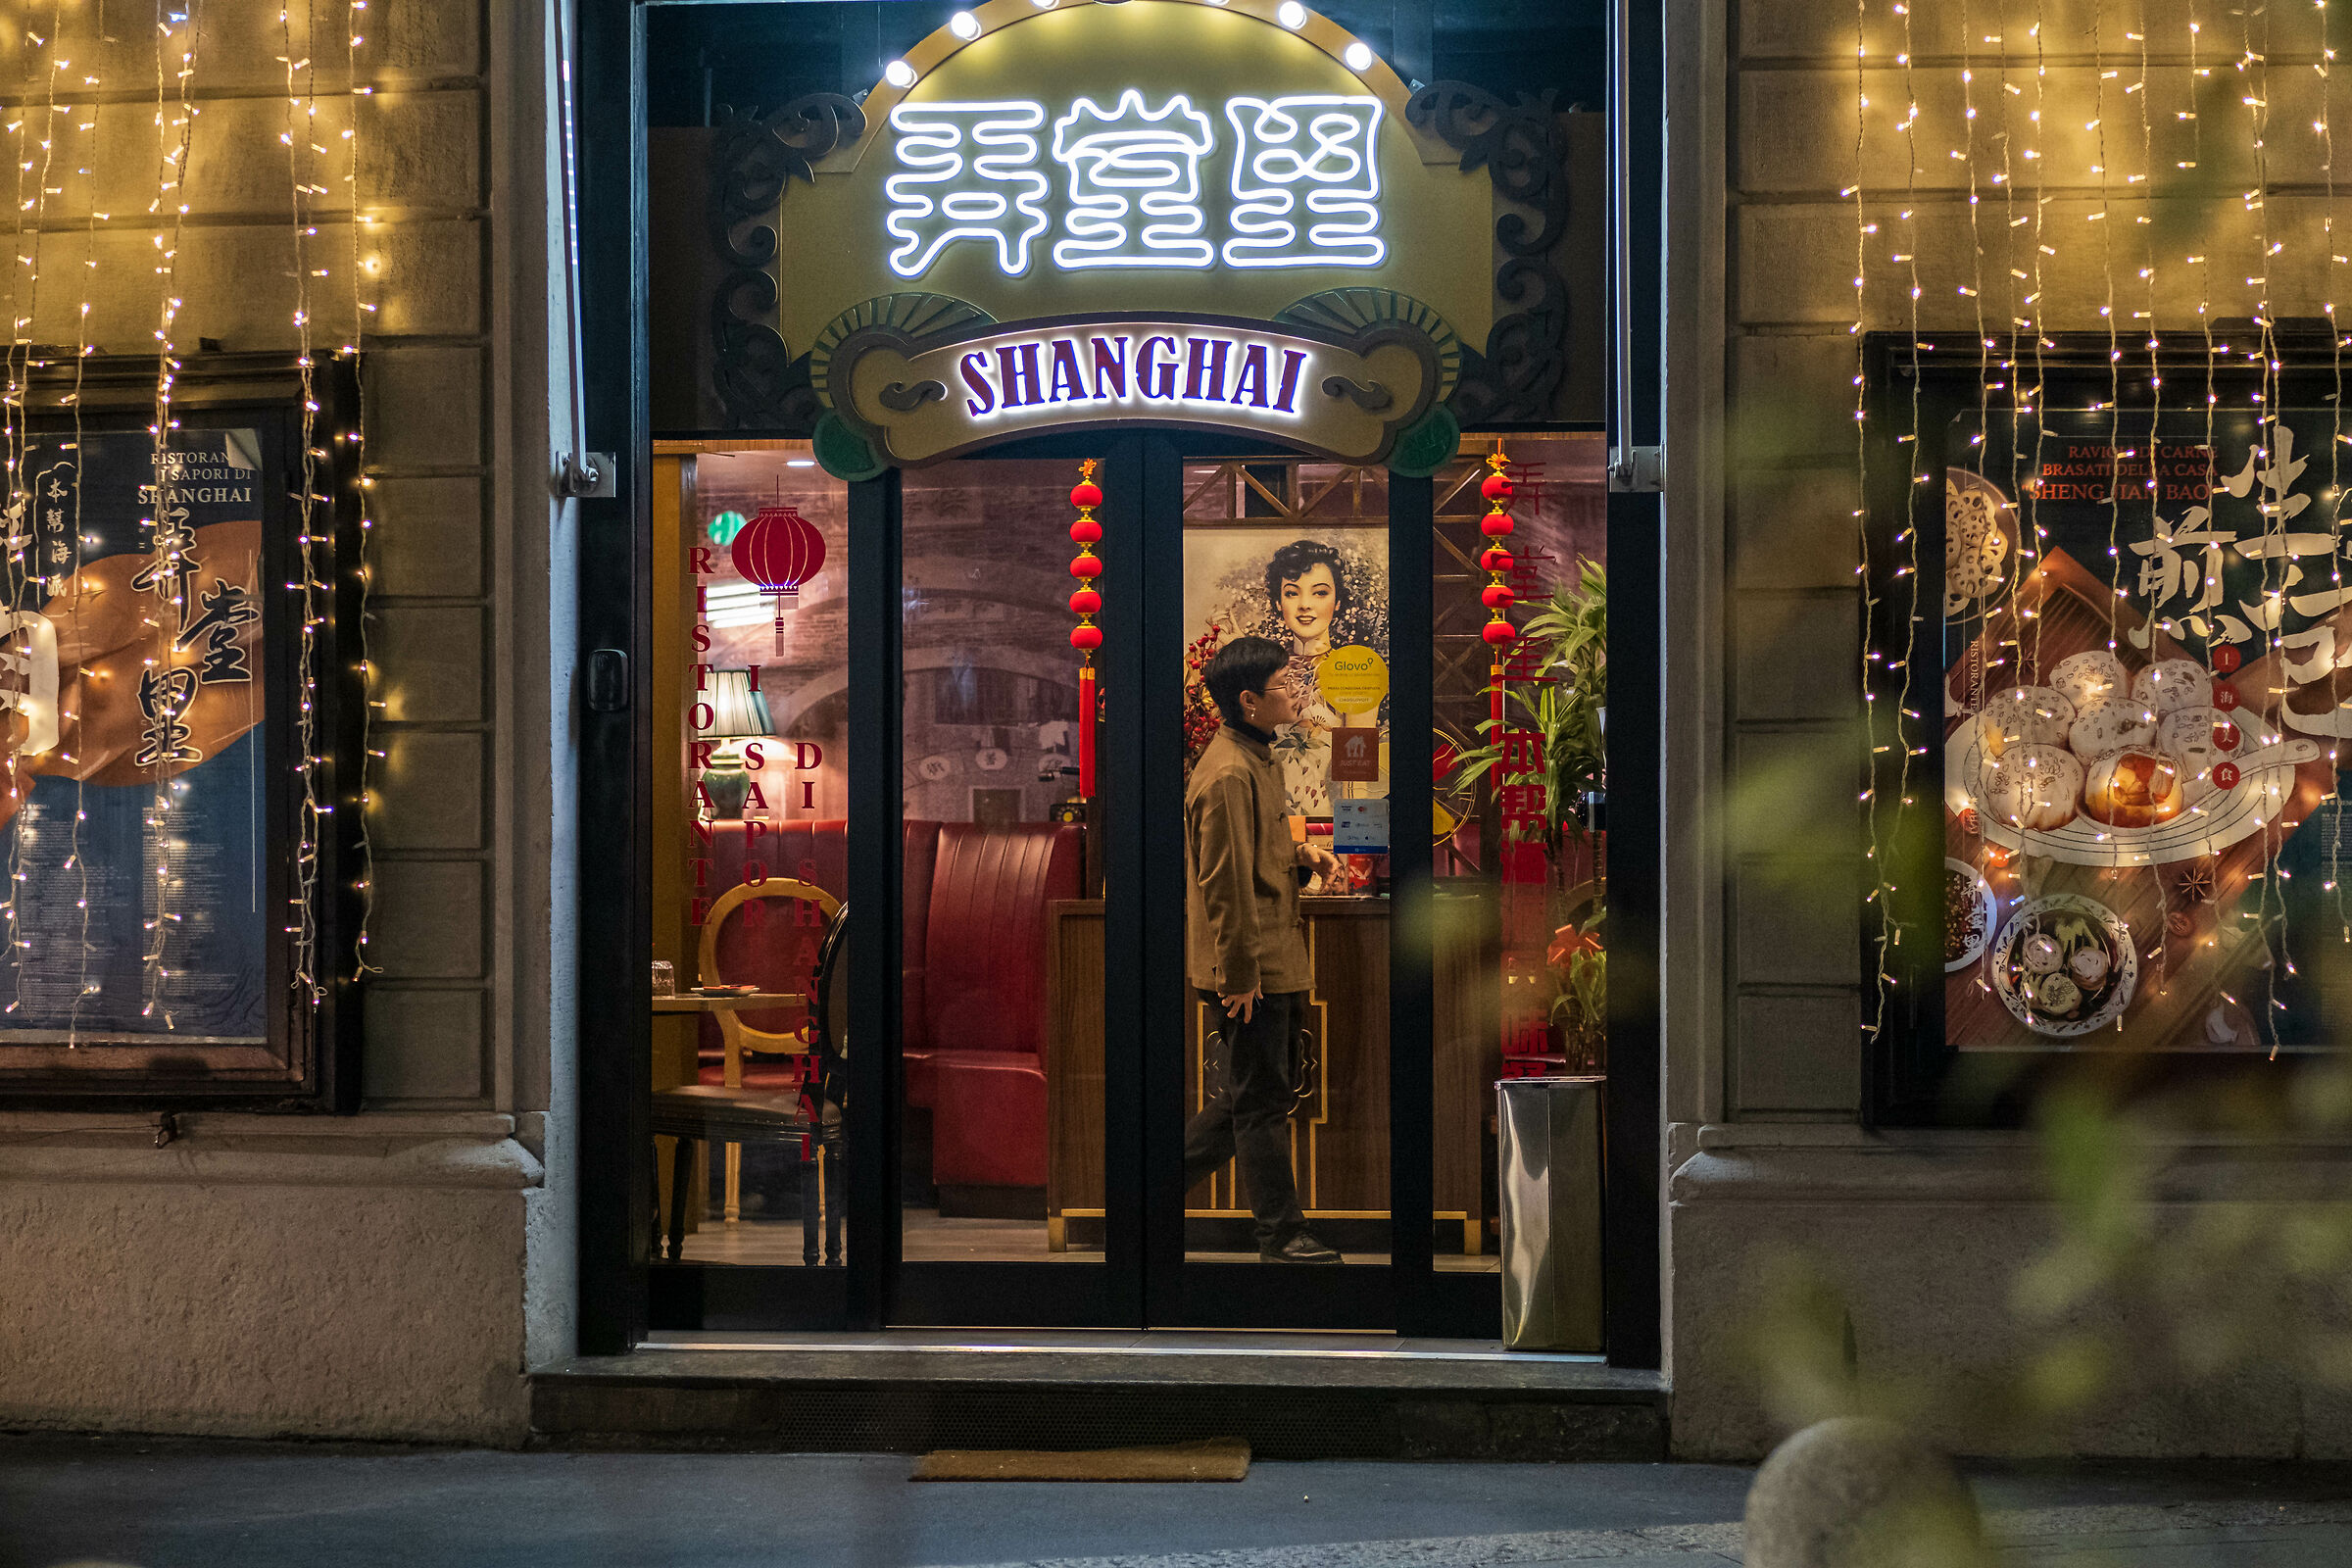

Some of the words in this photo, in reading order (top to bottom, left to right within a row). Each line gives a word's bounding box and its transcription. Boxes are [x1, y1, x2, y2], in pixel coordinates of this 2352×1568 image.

[959, 335, 1307, 416] SHANGHAI
[172, 469, 228, 480] SAPORI
[235, 469, 251, 479] DI
[2042, 464, 2110, 476] BRASATI
[2116, 465, 2171, 476] DELA
[2174, 464, 2218, 476] CASA
[138, 488, 252, 504] SHANGHAI
[2164, 484, 2217, 500] BAO
[1334, 660, 1369, 671] Glovo
[688, 547, 715, 926] RISTORANTE
[795, 742, 823, 808] DI
[792, 858, 824, 1161] SHANGHAI
